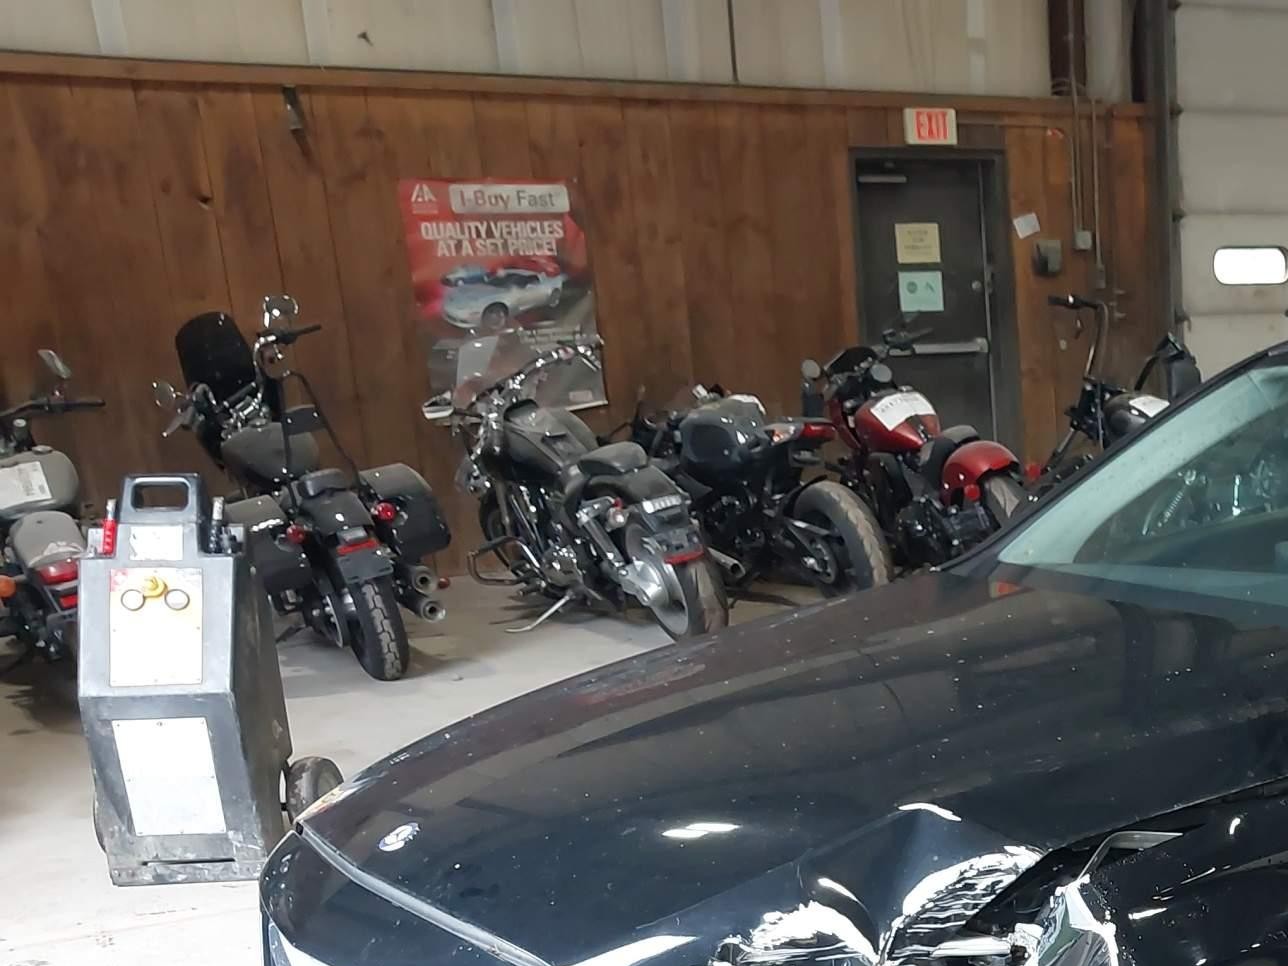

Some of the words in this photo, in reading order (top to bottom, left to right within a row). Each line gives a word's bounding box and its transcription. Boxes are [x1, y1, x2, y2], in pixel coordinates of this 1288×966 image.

[916, 109, 947, 139] EXIT
[460, 189, 510, 209] I-Buy
[516, 190, 556, 207] Fast
[420, 221, 488, 240] QUALITY
[489, 221, 564, 239] VEHICLES
[438, 239, 461, 256] AT
[462, 239, 475, 256] A
[476, 238, 504, 256] SET
[508, 238, 558, 256] PRICE!
